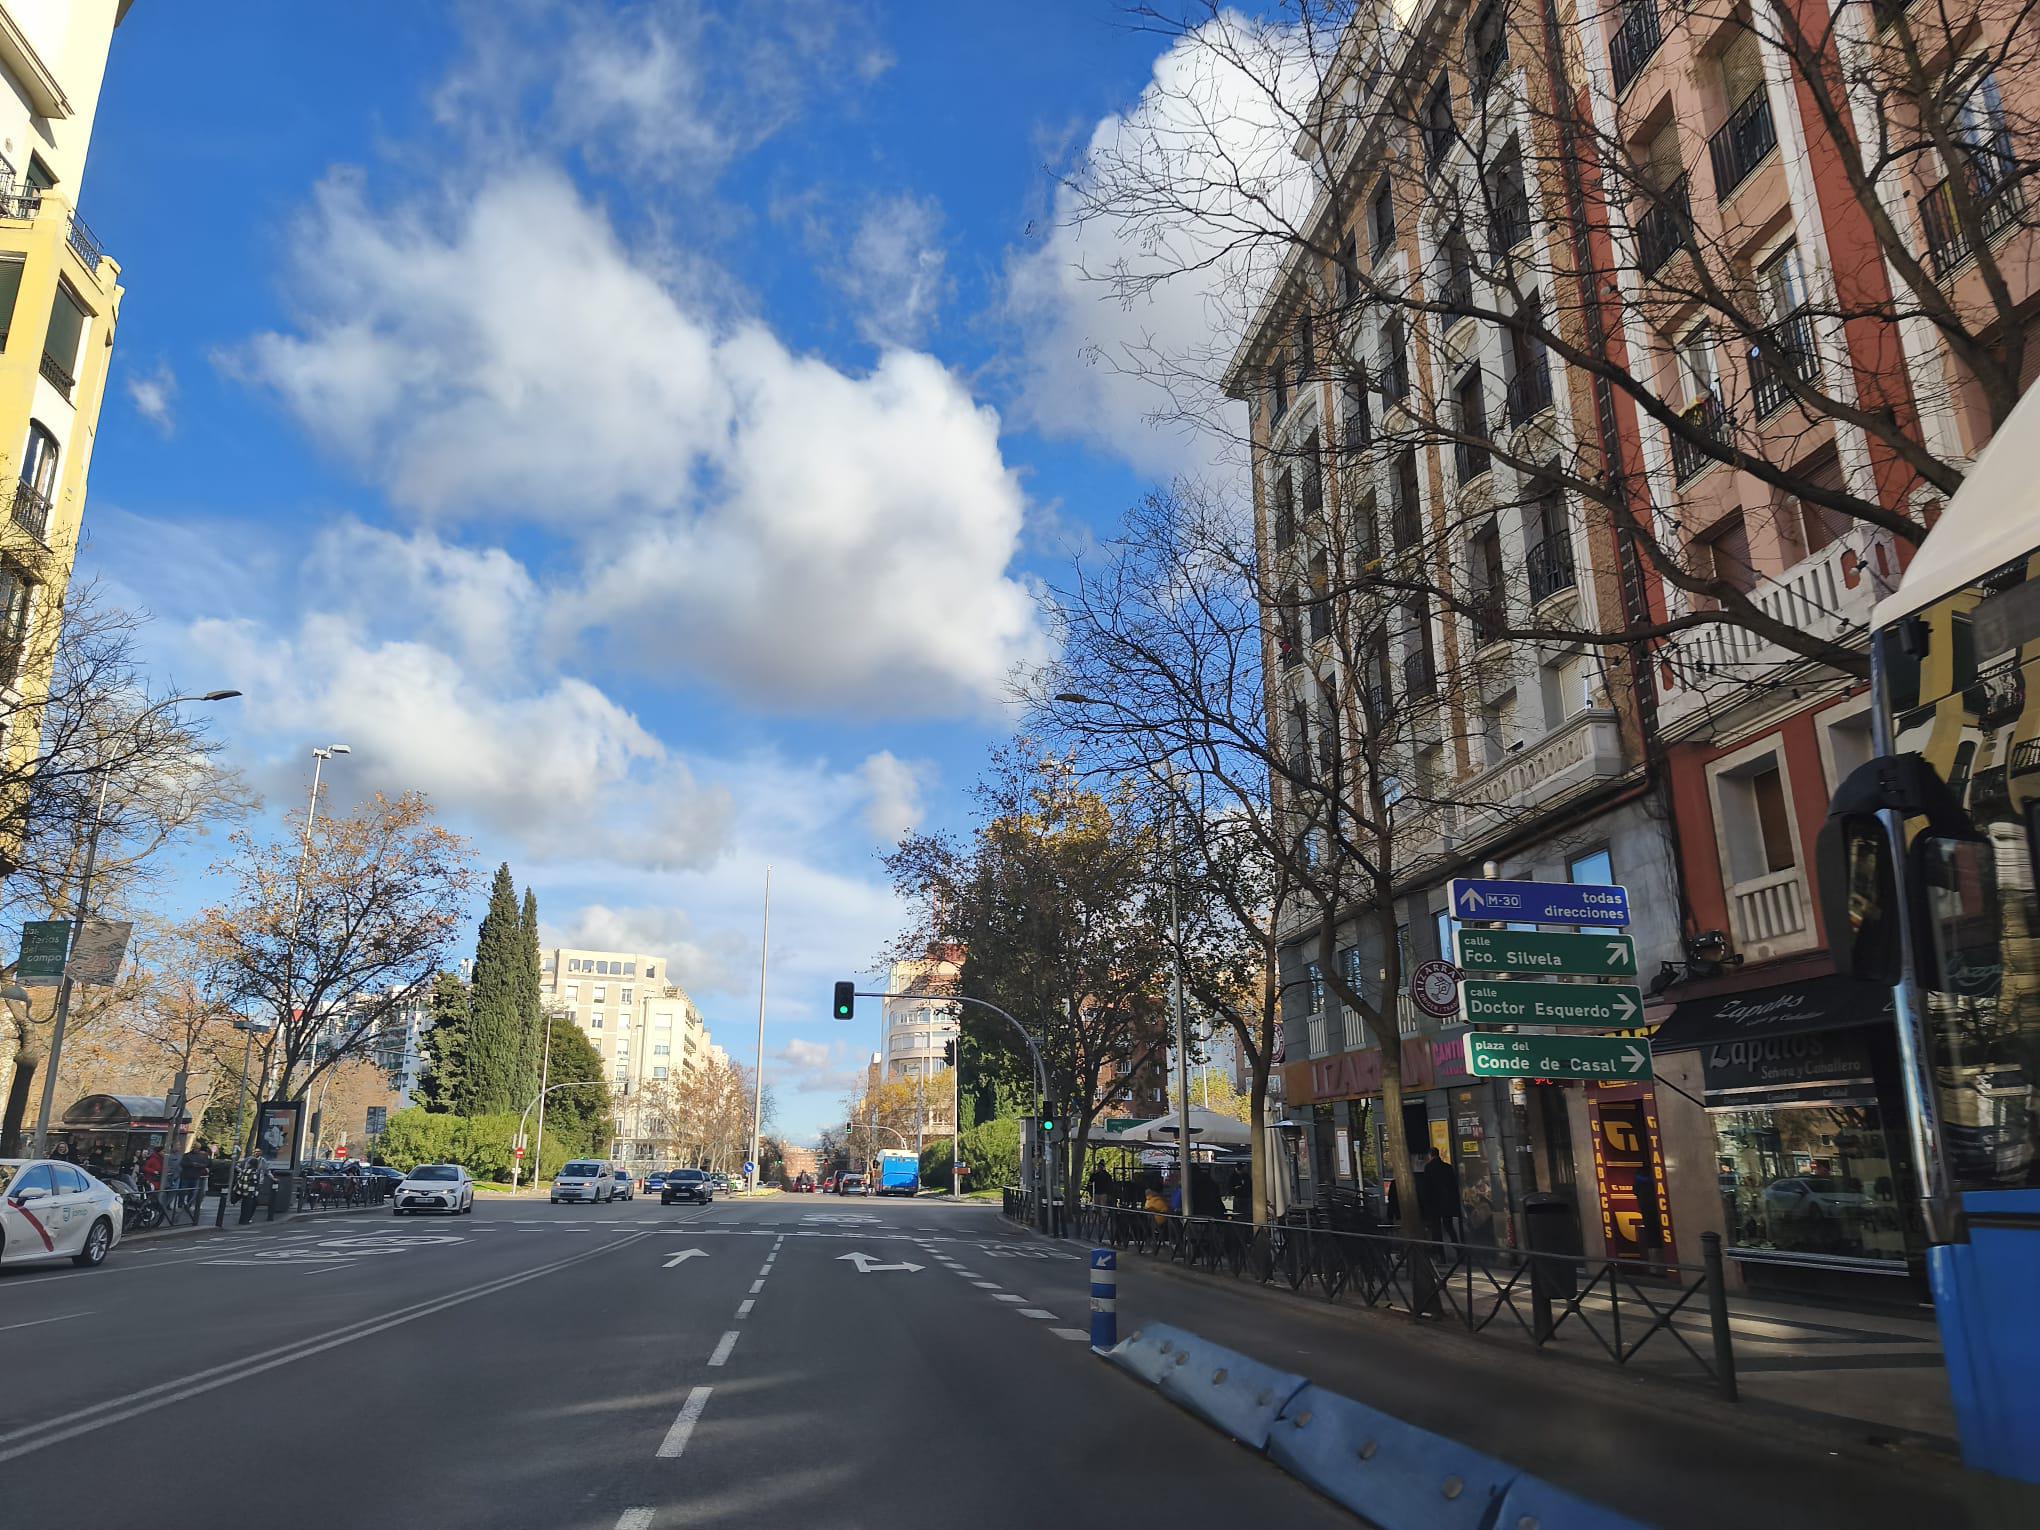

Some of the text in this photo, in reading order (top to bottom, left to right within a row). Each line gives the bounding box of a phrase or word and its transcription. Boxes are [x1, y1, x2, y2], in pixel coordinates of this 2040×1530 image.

[1488, 895, 1519, 907] M-30
[1583, 892, 1622, 905] todas
[1544, 905, 1625, 920] direcciones
[1464, 936, 1491, 946] calle
[27, 955, 62, 963] campo
[1465, 950, 1562, 966] Fco. Silvela
[1470, 987, 1498, 997] calle
[1471, 1000, 1525, 1015] Doctor
[1535, 1003, 1610, 1020] Esquerdo
[1475, 1040, 1530, 1051] plaza del
[1477, 1055, 1617, 1073] Conde de Casal
[1594, 1138, 1613, 1239] TABACOS
[1650, 1135, 1672, 1243] TABACOS
